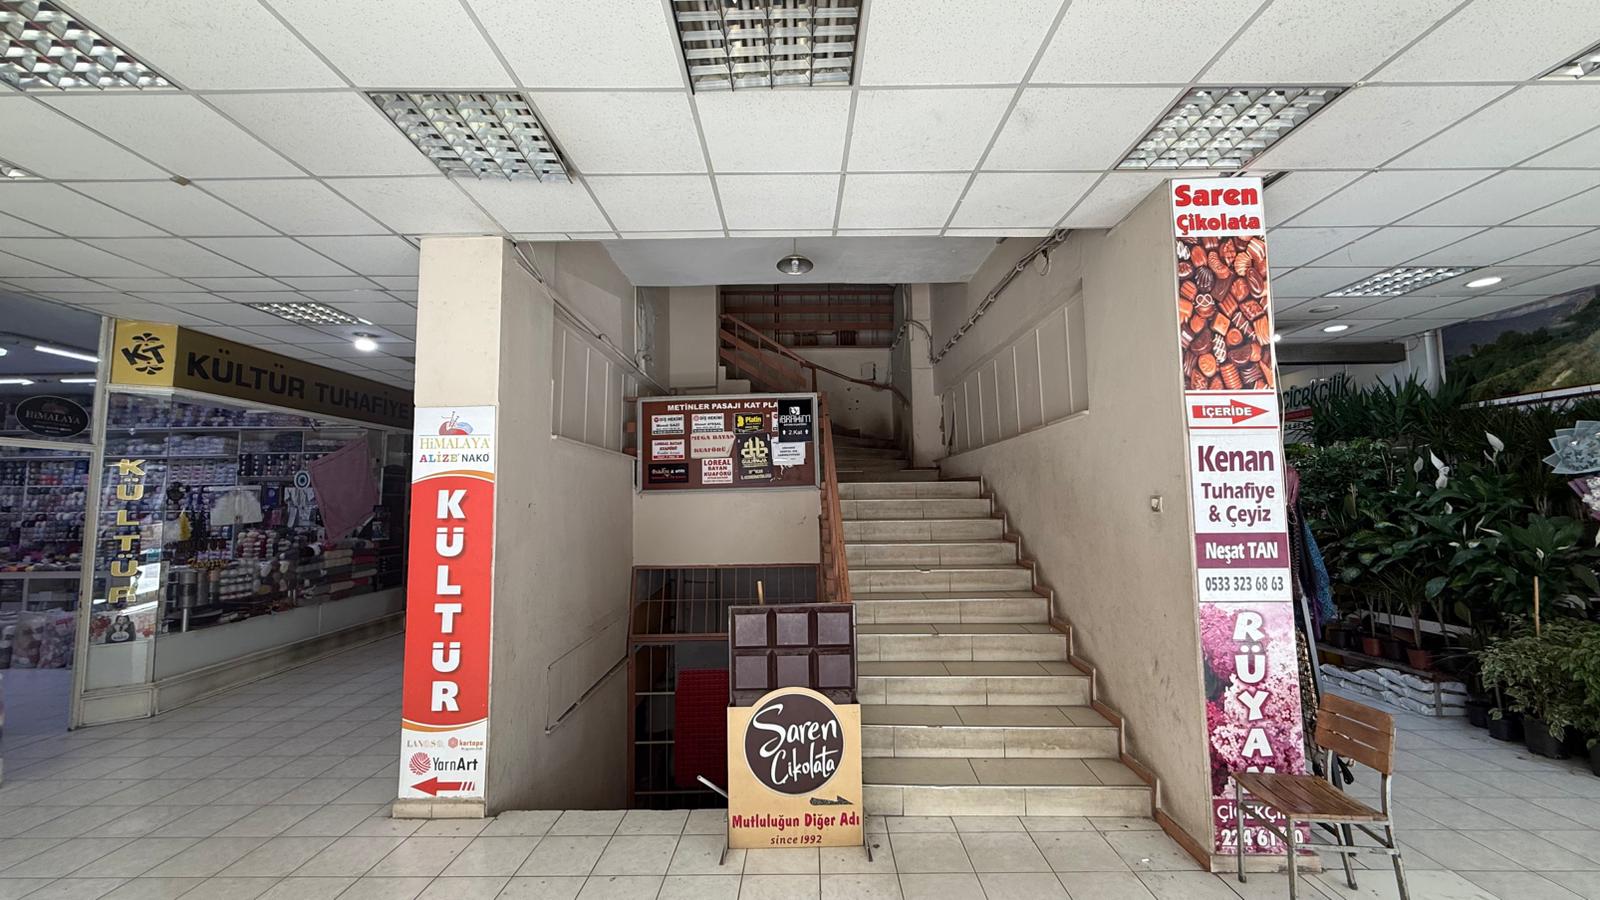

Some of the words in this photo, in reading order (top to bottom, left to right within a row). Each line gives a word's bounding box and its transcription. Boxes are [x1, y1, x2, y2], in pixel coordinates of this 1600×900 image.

[1174, 184, 1258, 207] Saren
[1177, 213, 1261, 235] Çikolata
[187, 349, 305, 399] KÜLTÜR
[315, 382, 409, 418] TUHAFİYE
[667, 403, 709, 411] METİNLER
[712, 402, 741, 410] PASAJI
[1202, 403, 1252, 418] İÇERİDE
[419, 451, 458, 463] ALİZE
[461, 453, 489, 463] NAKO
[1198, 446, 1274, 472] Kenan
[1201, 483, 1275, 503] Tuhafiye
[1209, 505, 1221, 523] &
[1226, 505, 1271, 527] Çeyiz
[108, 459, 145, 604] KÜLTÜR
[1205, 542, 1245, 563] Neşat
[1247, 542, 1278, 559] TAN
[1206, 577, 1230, 591] 0533
[1233, 577, 1252, 591] 323
[1255, 577, 1268, 591] 68
[1271, 577, 1284, 591] 63
[430, 490, 466, 712] KÜLTÜR
[752, 703, 837, 758] Saren
[433, 757, 478, 771] YarnArt
[732, 814, 800, 832] Mutluluğun
[804, 812, 836, 830] Diğer
[840, 811, 860, 827] Adı
[770, 835, 798, 845] since
[800, 834, 822, 845] 1992
